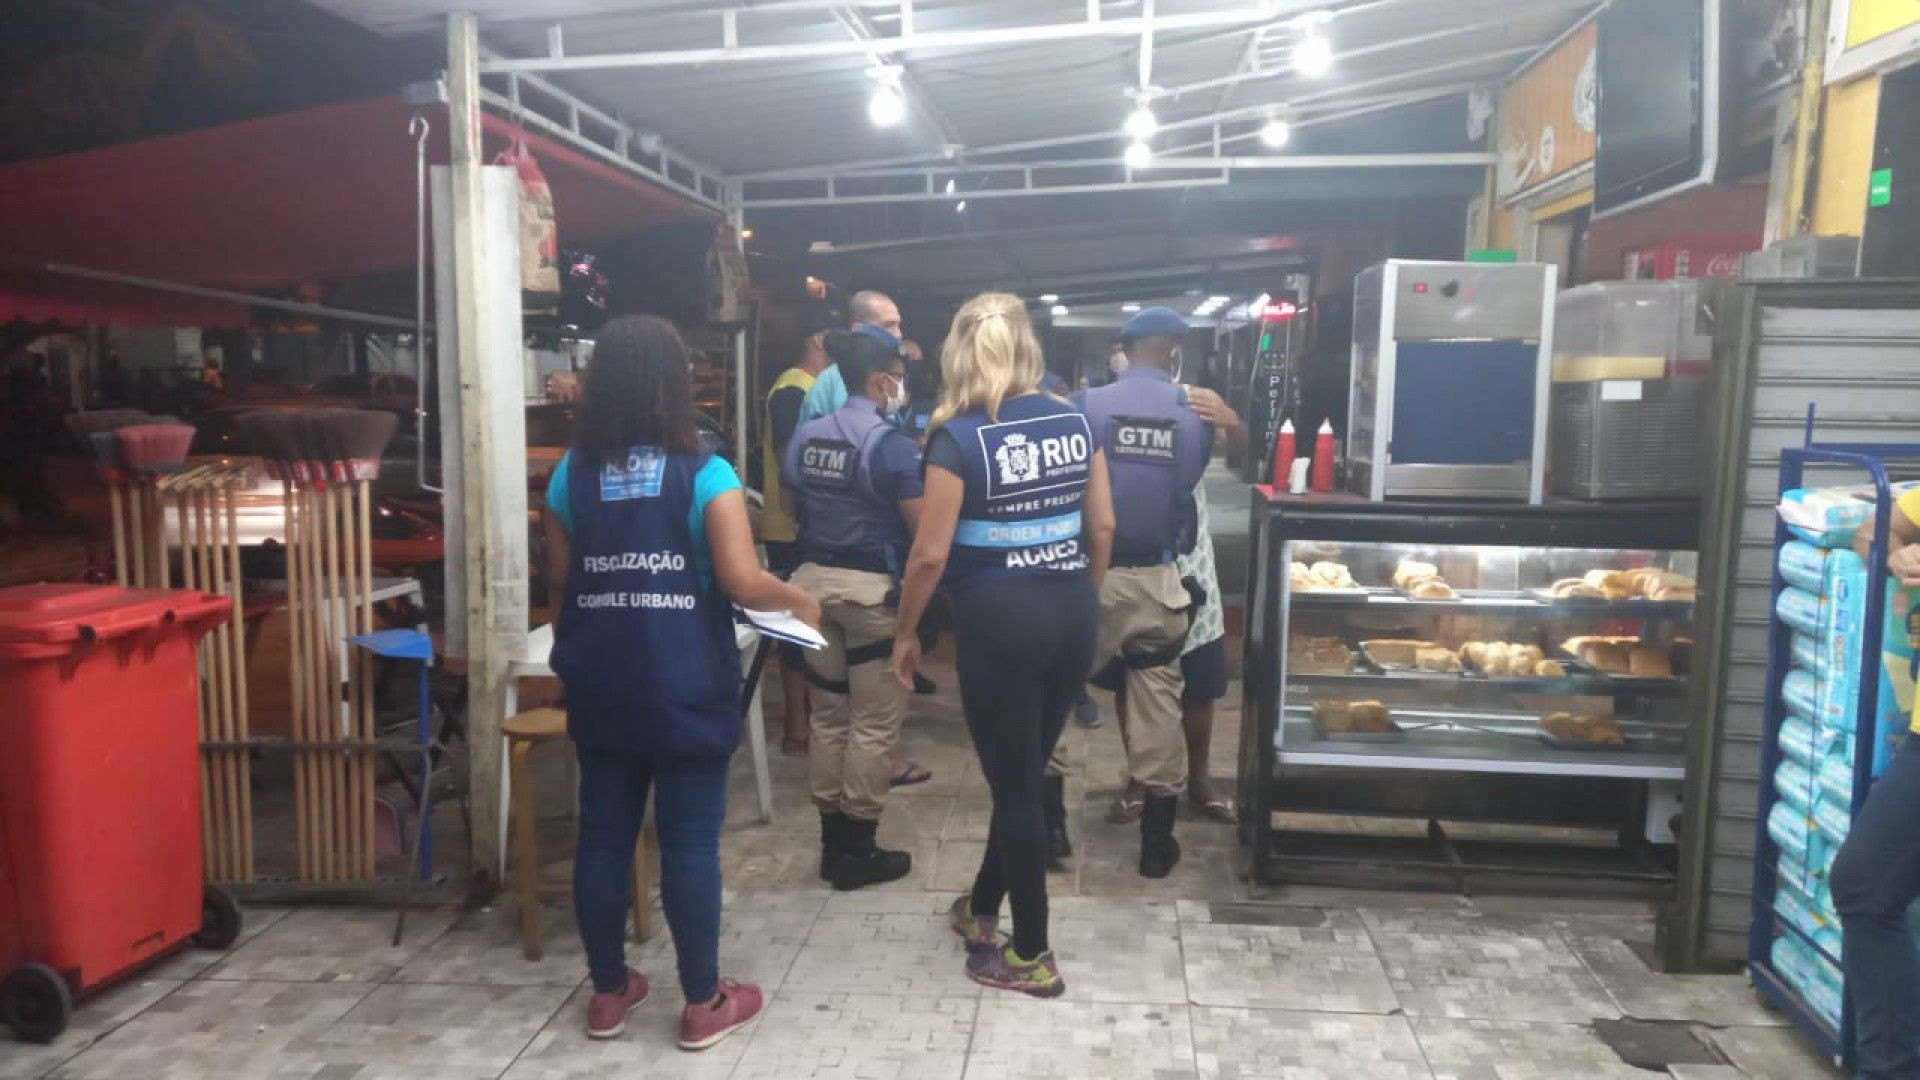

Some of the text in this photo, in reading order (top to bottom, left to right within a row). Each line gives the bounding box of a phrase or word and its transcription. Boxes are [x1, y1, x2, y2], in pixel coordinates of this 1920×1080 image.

[1118, 426, 1173, 448] GTM
[803, 446, 848, 471] GTM
[1041, 433, 1087, 468] RIO
[629, 592, 696, 610] URBANO
